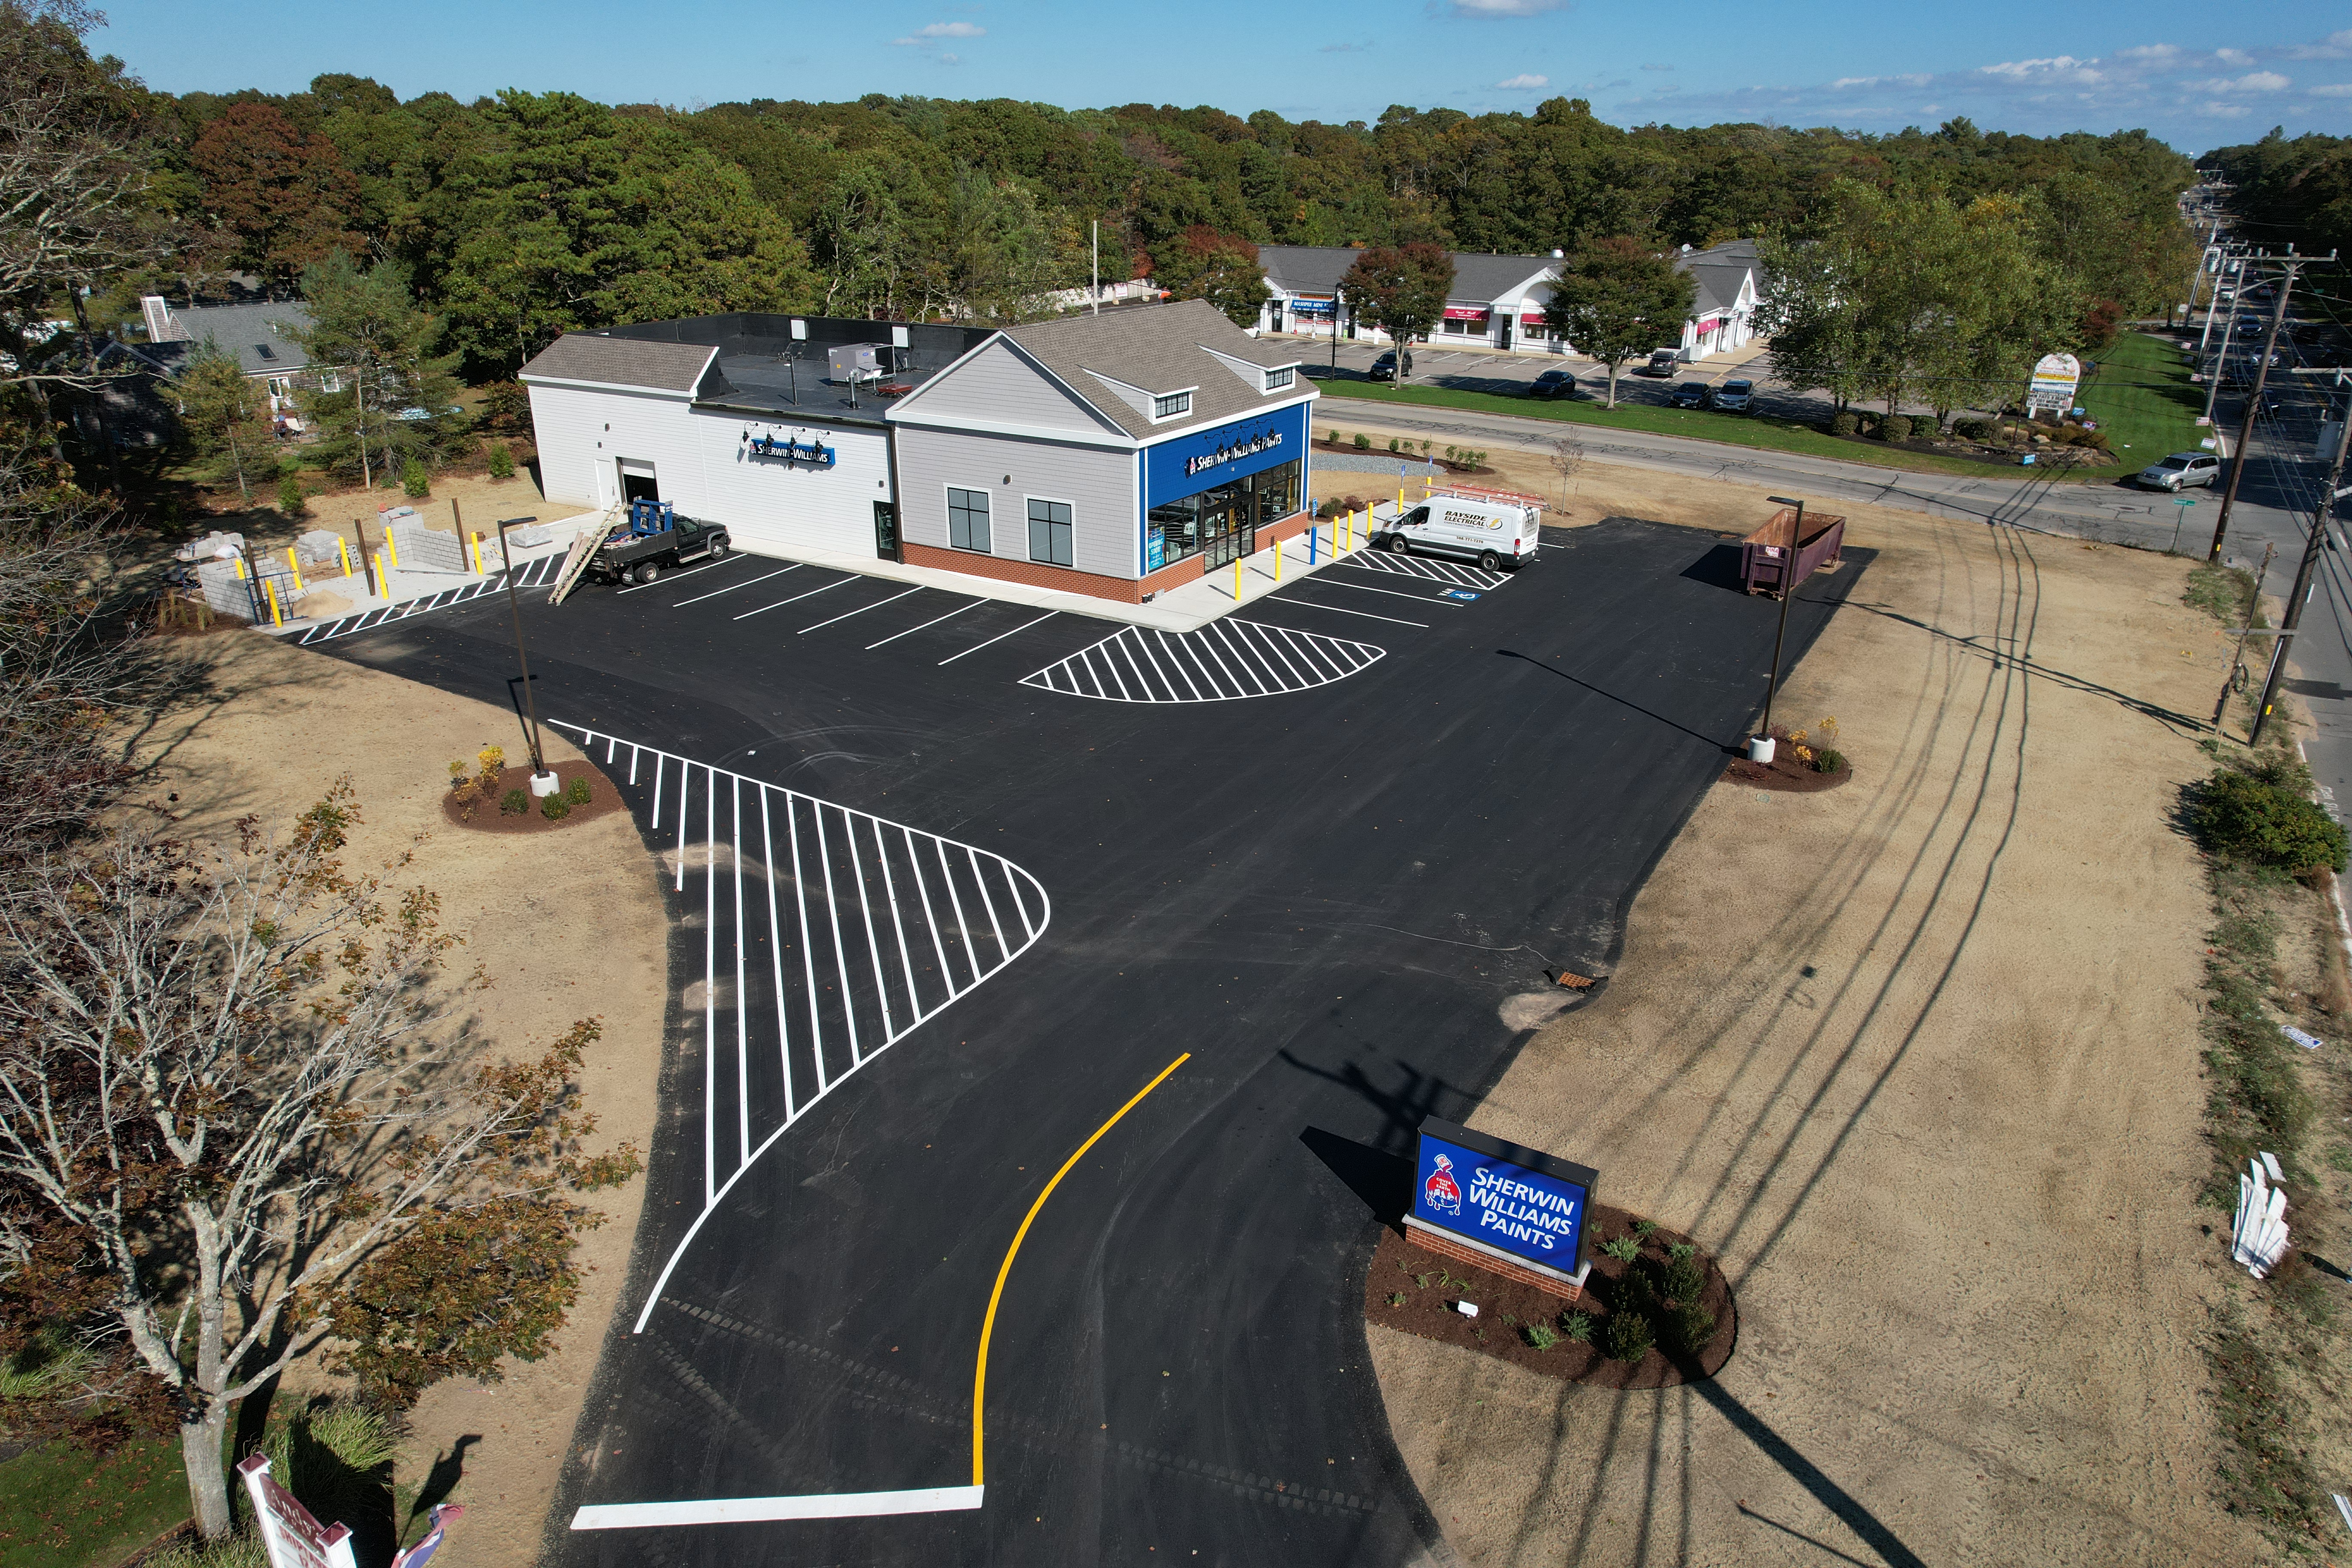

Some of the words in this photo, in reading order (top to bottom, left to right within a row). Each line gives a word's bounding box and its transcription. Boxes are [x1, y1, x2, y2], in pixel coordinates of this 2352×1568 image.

[758, 444, 828, 462] SHERWIN-WILLIAMS
[1197, 441, 1260, 471] SHERWIN-WILLIAMS
[1262, 433, 1283, 450] PAINTS
[1444, 516, 1485, 527] ELECTRICAL
[1445, 510, 1488, 521] BAYSIDE
[1149, 538, 1163, 548] OPENING
[1151, 546, 1161, 555] SOON!
[1437, 588, 1456, 596] VAN
[1436, 1177, 1451, 1185] COVER
[1472, 1167, 1575, 1216] SHERWIN
[1470, 1184, 1572, 1235] WILLIAMS
[1480, 1210, 1555, 1249] PAINTS
[279, 1525, 328, 1568] SHIPYAR
